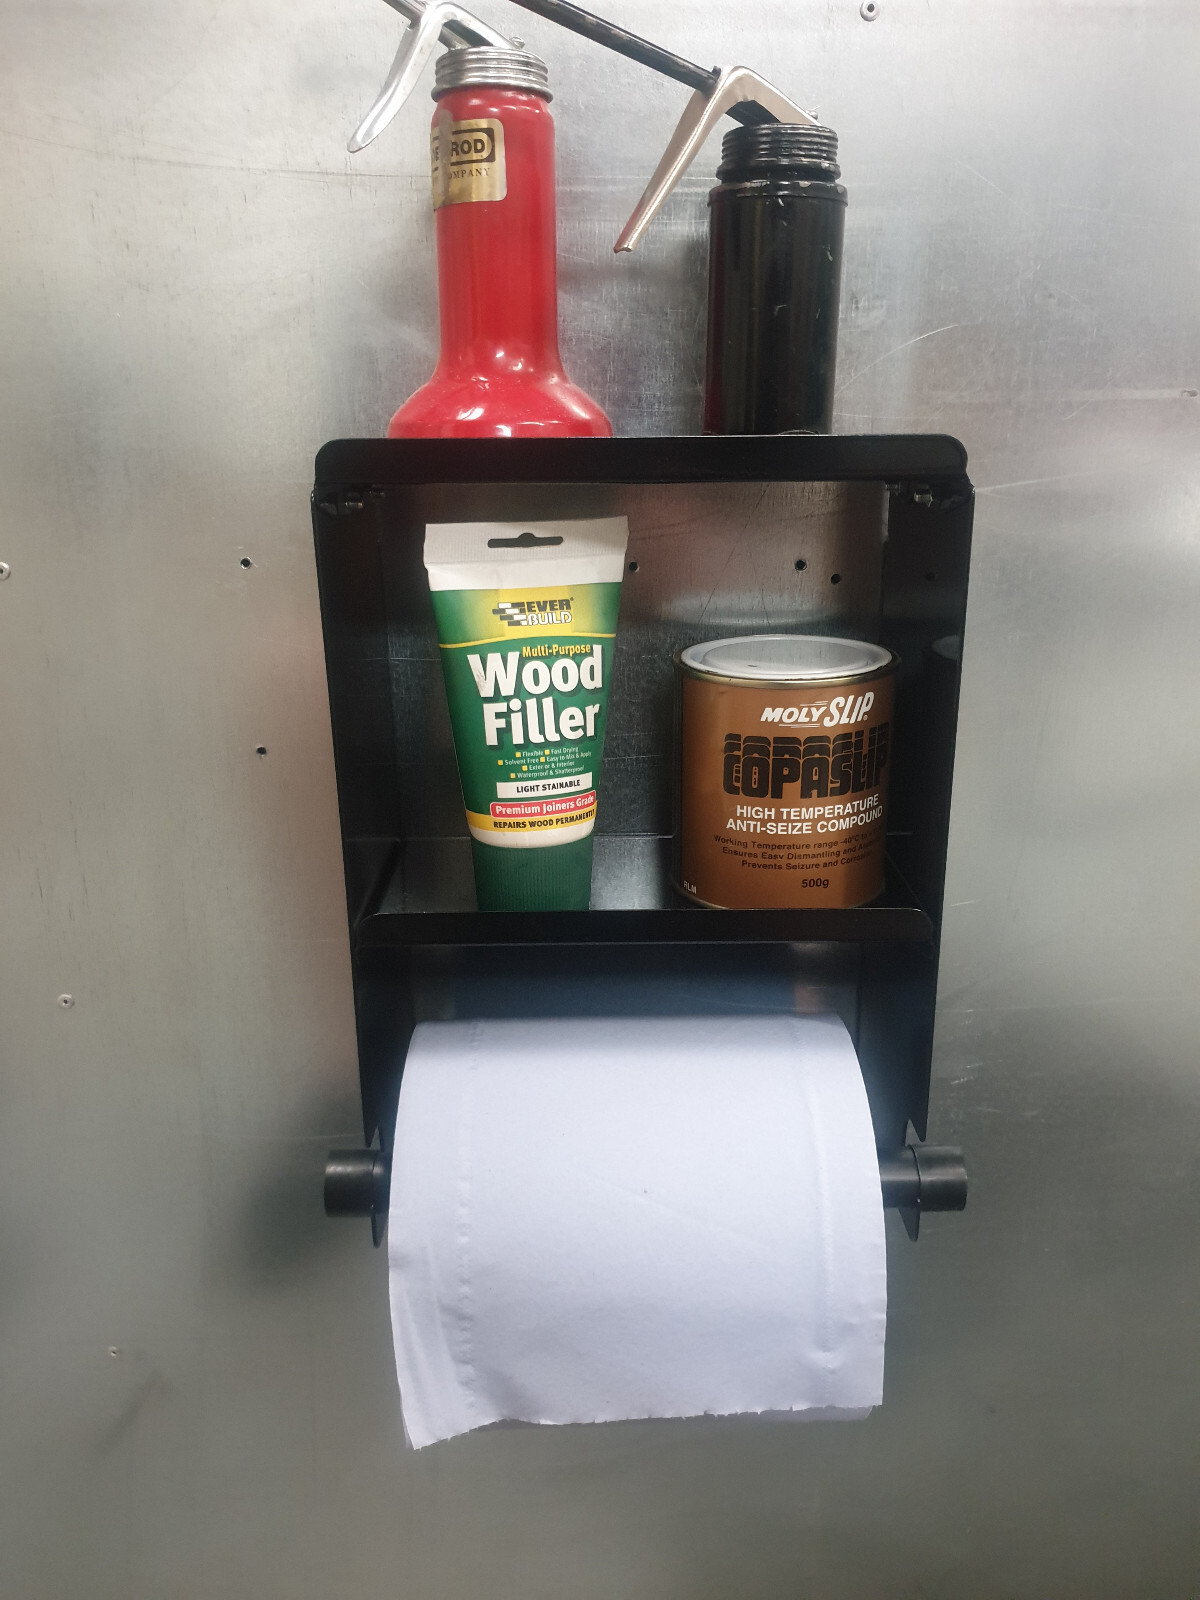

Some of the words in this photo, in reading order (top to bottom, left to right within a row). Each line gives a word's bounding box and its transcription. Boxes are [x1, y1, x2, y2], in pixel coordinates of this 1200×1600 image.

[526, 599, 571, 613] EVER
[526, 611, 572, 627] BUILD
[522, 643, 591, 658] Multi-Purpose
[467, 644, 603, 698] Wood
[483, 696, 600, 746] Filler
[722, 722, 890, 800] COPASLIP
[516, 770, 549, 779] Waterproof
[516, 784, 540, 793] LIGHT
[541, 779, 580, 792] STAINABLE
[495, 804, 540, 815] Premium
[543, 800, 574, 814] Joiners
[576, 794, 594, 807] Grade
[736, 804, 775, 820] HIGH
[780, 793, 880, 820] TEMPERATURE
[493, 820, 527, 829] REPAIRS
[528, 818, 554, 828] WOOD
[726, 818, 812, 835] ANTI-SEIZE
[817, 805, 883, 834] COMPOUND
[713, 834, 748, 849] Working
[752, 841, 811, 851] Temperature
[814, 840, 839, 850] range
[722, 847, 758, 859] Ensures
[787, 849, 841, 860] Dismantling
[843, 845, 857, 855] and
[742, 860, 783, 870] Prevents
[785, 861, 820, 871] Seizure
[822, 859, 838, 869] and
[801, 878, 830, 889] 500g
